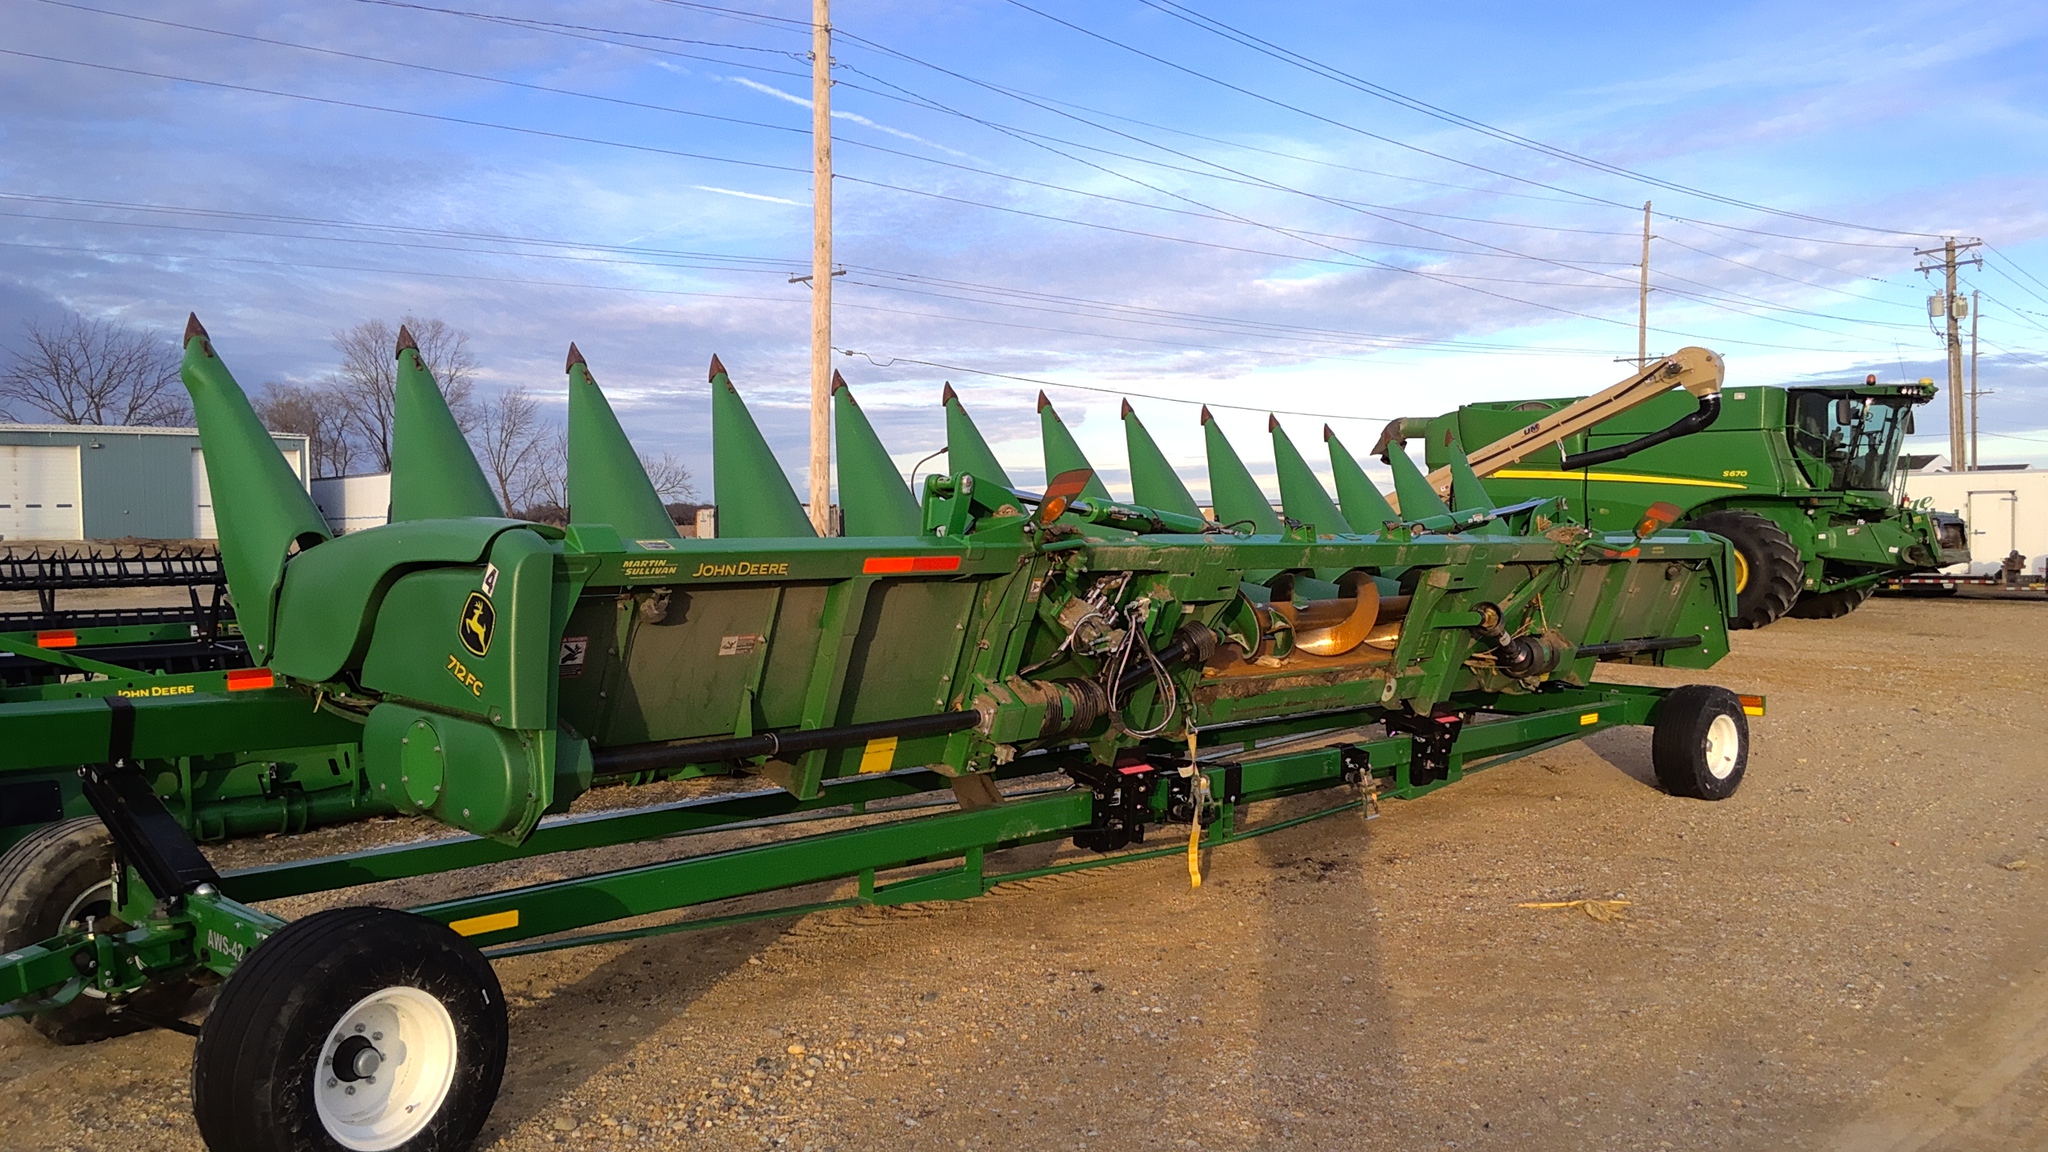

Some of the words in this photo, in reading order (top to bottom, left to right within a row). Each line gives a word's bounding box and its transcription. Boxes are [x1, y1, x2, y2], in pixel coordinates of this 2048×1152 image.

[622, 559, 667, 568] MARTIN
[692, 563, 737, 577] JOHN
[737, 562, 789, 576] DEERE
[624, 566, 677, 576] SULLIVAN
[484, 568, 497, 594] 4
[151, 685, 195, 697] DEERE
